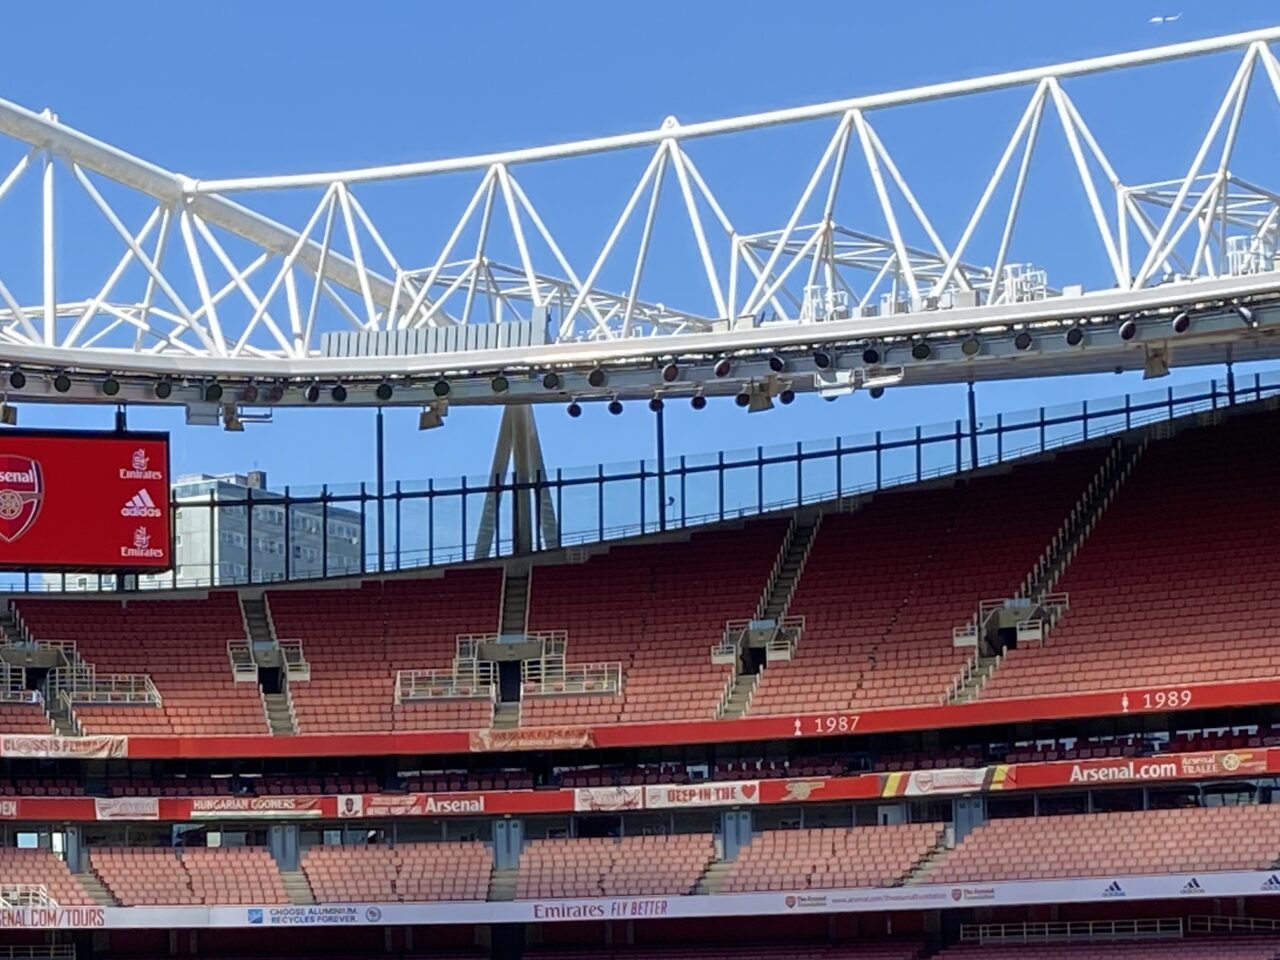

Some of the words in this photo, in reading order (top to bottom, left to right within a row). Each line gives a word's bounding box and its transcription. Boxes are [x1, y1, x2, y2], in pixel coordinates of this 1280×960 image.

[120, 469, 163, 480] Emirates
[121, 507, 162, 518] adidas
[121, 546, 164, 557] Emirates
[1143, 690, 1192, 709] 1989
[814, 716, 860, 733] 1987
[1070, 762, 1177, 782] Arsenal.com
[667, 789, 696, 803] DEEP
[698, 789, 712, 800] IN
[714, 786, 737, 800] THE
[193, 800, 248, 809] HUNGARIAN
[251, 799, 296, 809] GOONERS
[425, 796, 485, 813] Arsenal
[533, 902, 604, 919] Emirates
[610, 901, 628, 916] FLY
[630, 900, 668, 915] BETTER
